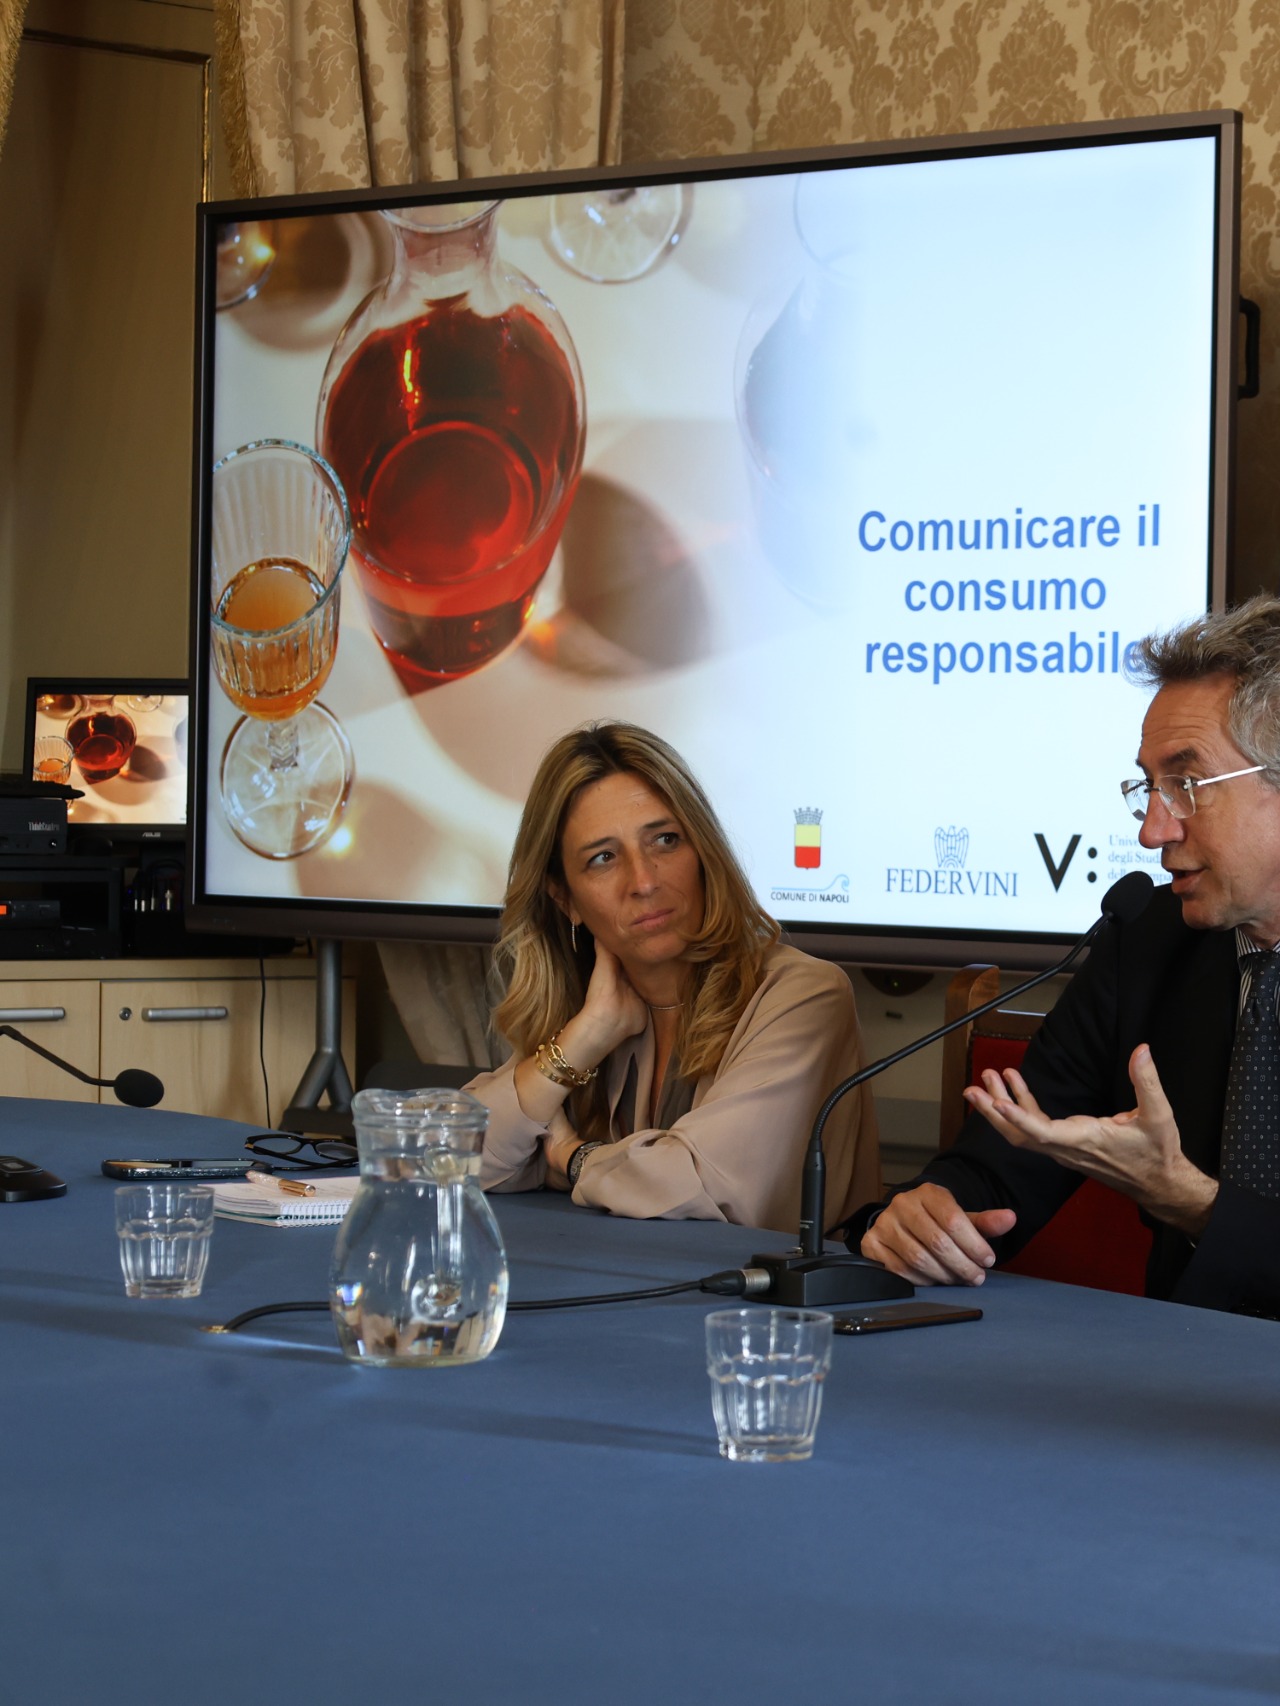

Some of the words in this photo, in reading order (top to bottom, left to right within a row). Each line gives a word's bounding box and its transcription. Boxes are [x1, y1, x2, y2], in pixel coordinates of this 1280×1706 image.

[858, 507, 1121, 552] Comunicare
[1138, 503, 1161, 547] il
[904, 577, 1107, 612] consumo
[1109, 834, 1140, 846] Unive
[1108, 851, 1133, 865] degli
[885, 867, 1019, 897] FEDERVINI
[770, 891, 806, 902] COMUNE
[808, 892, 817, 902] DI
[819, 893, 850, 903] NAPOLI
